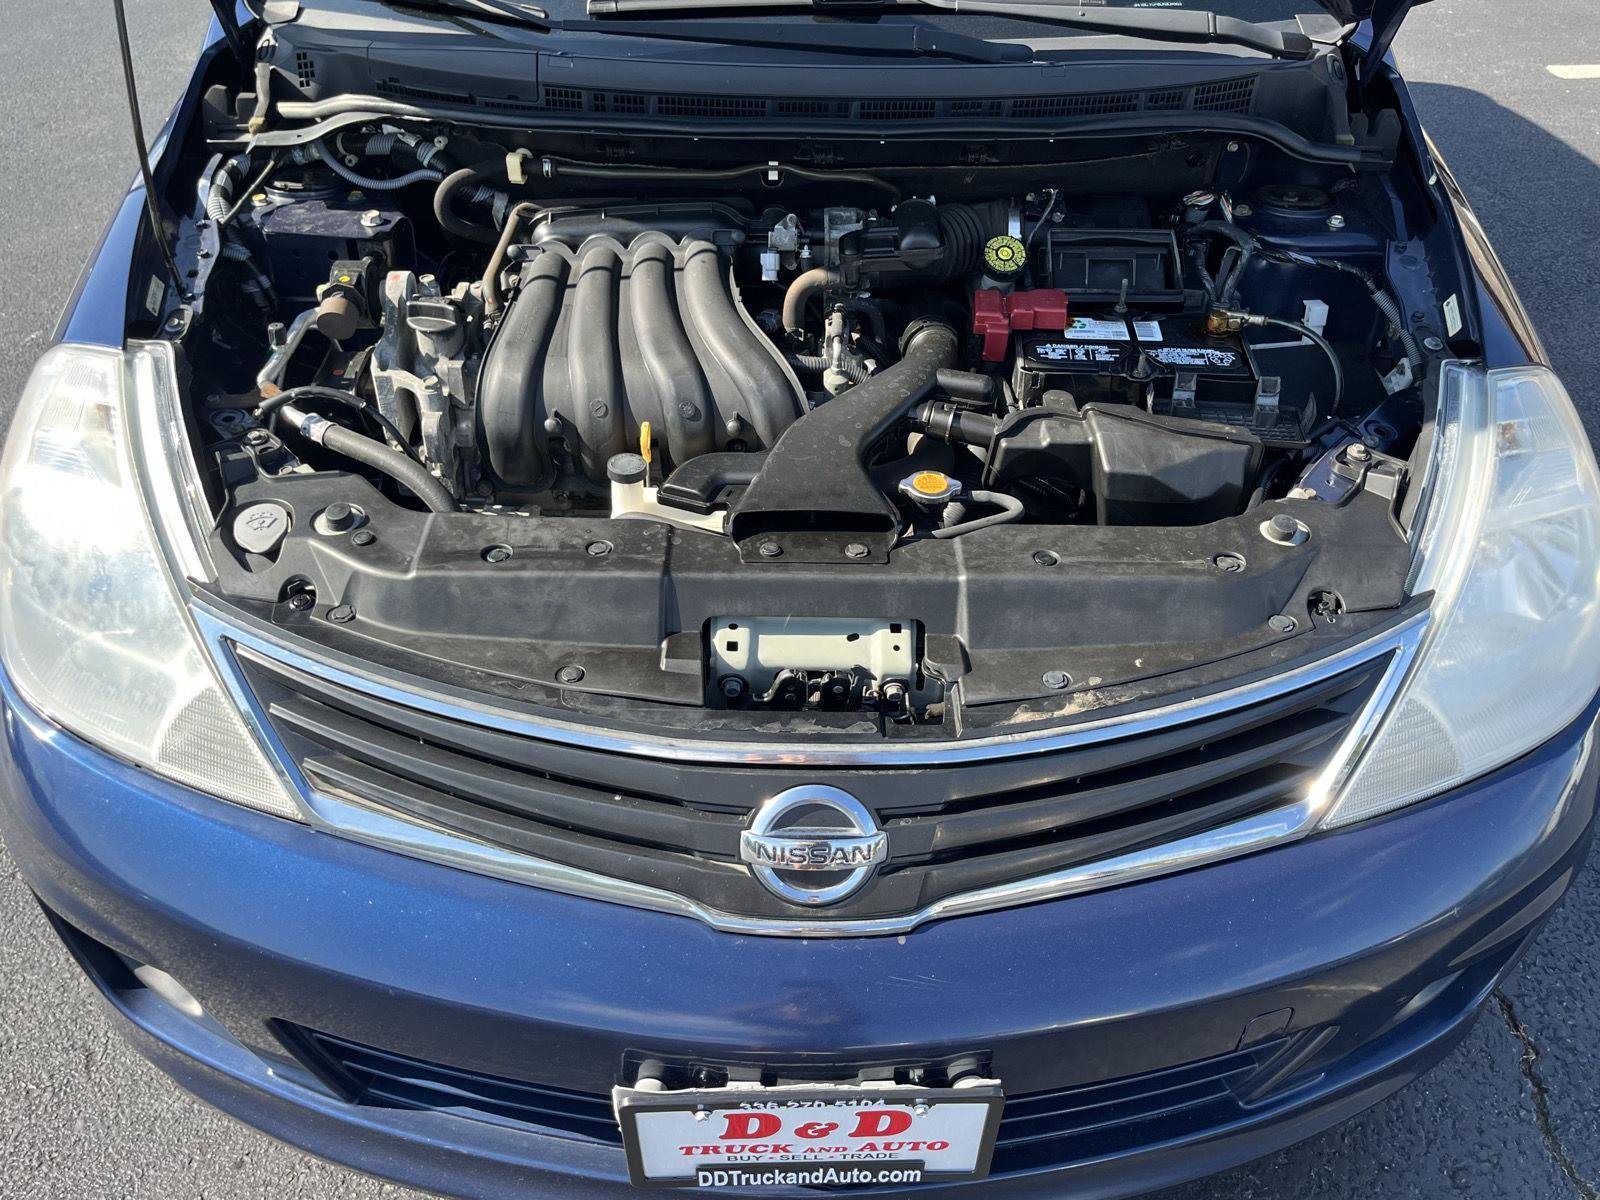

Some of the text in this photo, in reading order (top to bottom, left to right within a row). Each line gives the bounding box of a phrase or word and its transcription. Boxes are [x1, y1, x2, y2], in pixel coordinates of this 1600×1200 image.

[756, 842, 871, 864] NISSAN
[719, 1110, 912, 1140] D & D
[679, 1144, 793, 1156] TRUCK
[856, 1141, 949, 1152] AUTO
[698, 1168, 921, 1187] DDTruckandAuto.com
